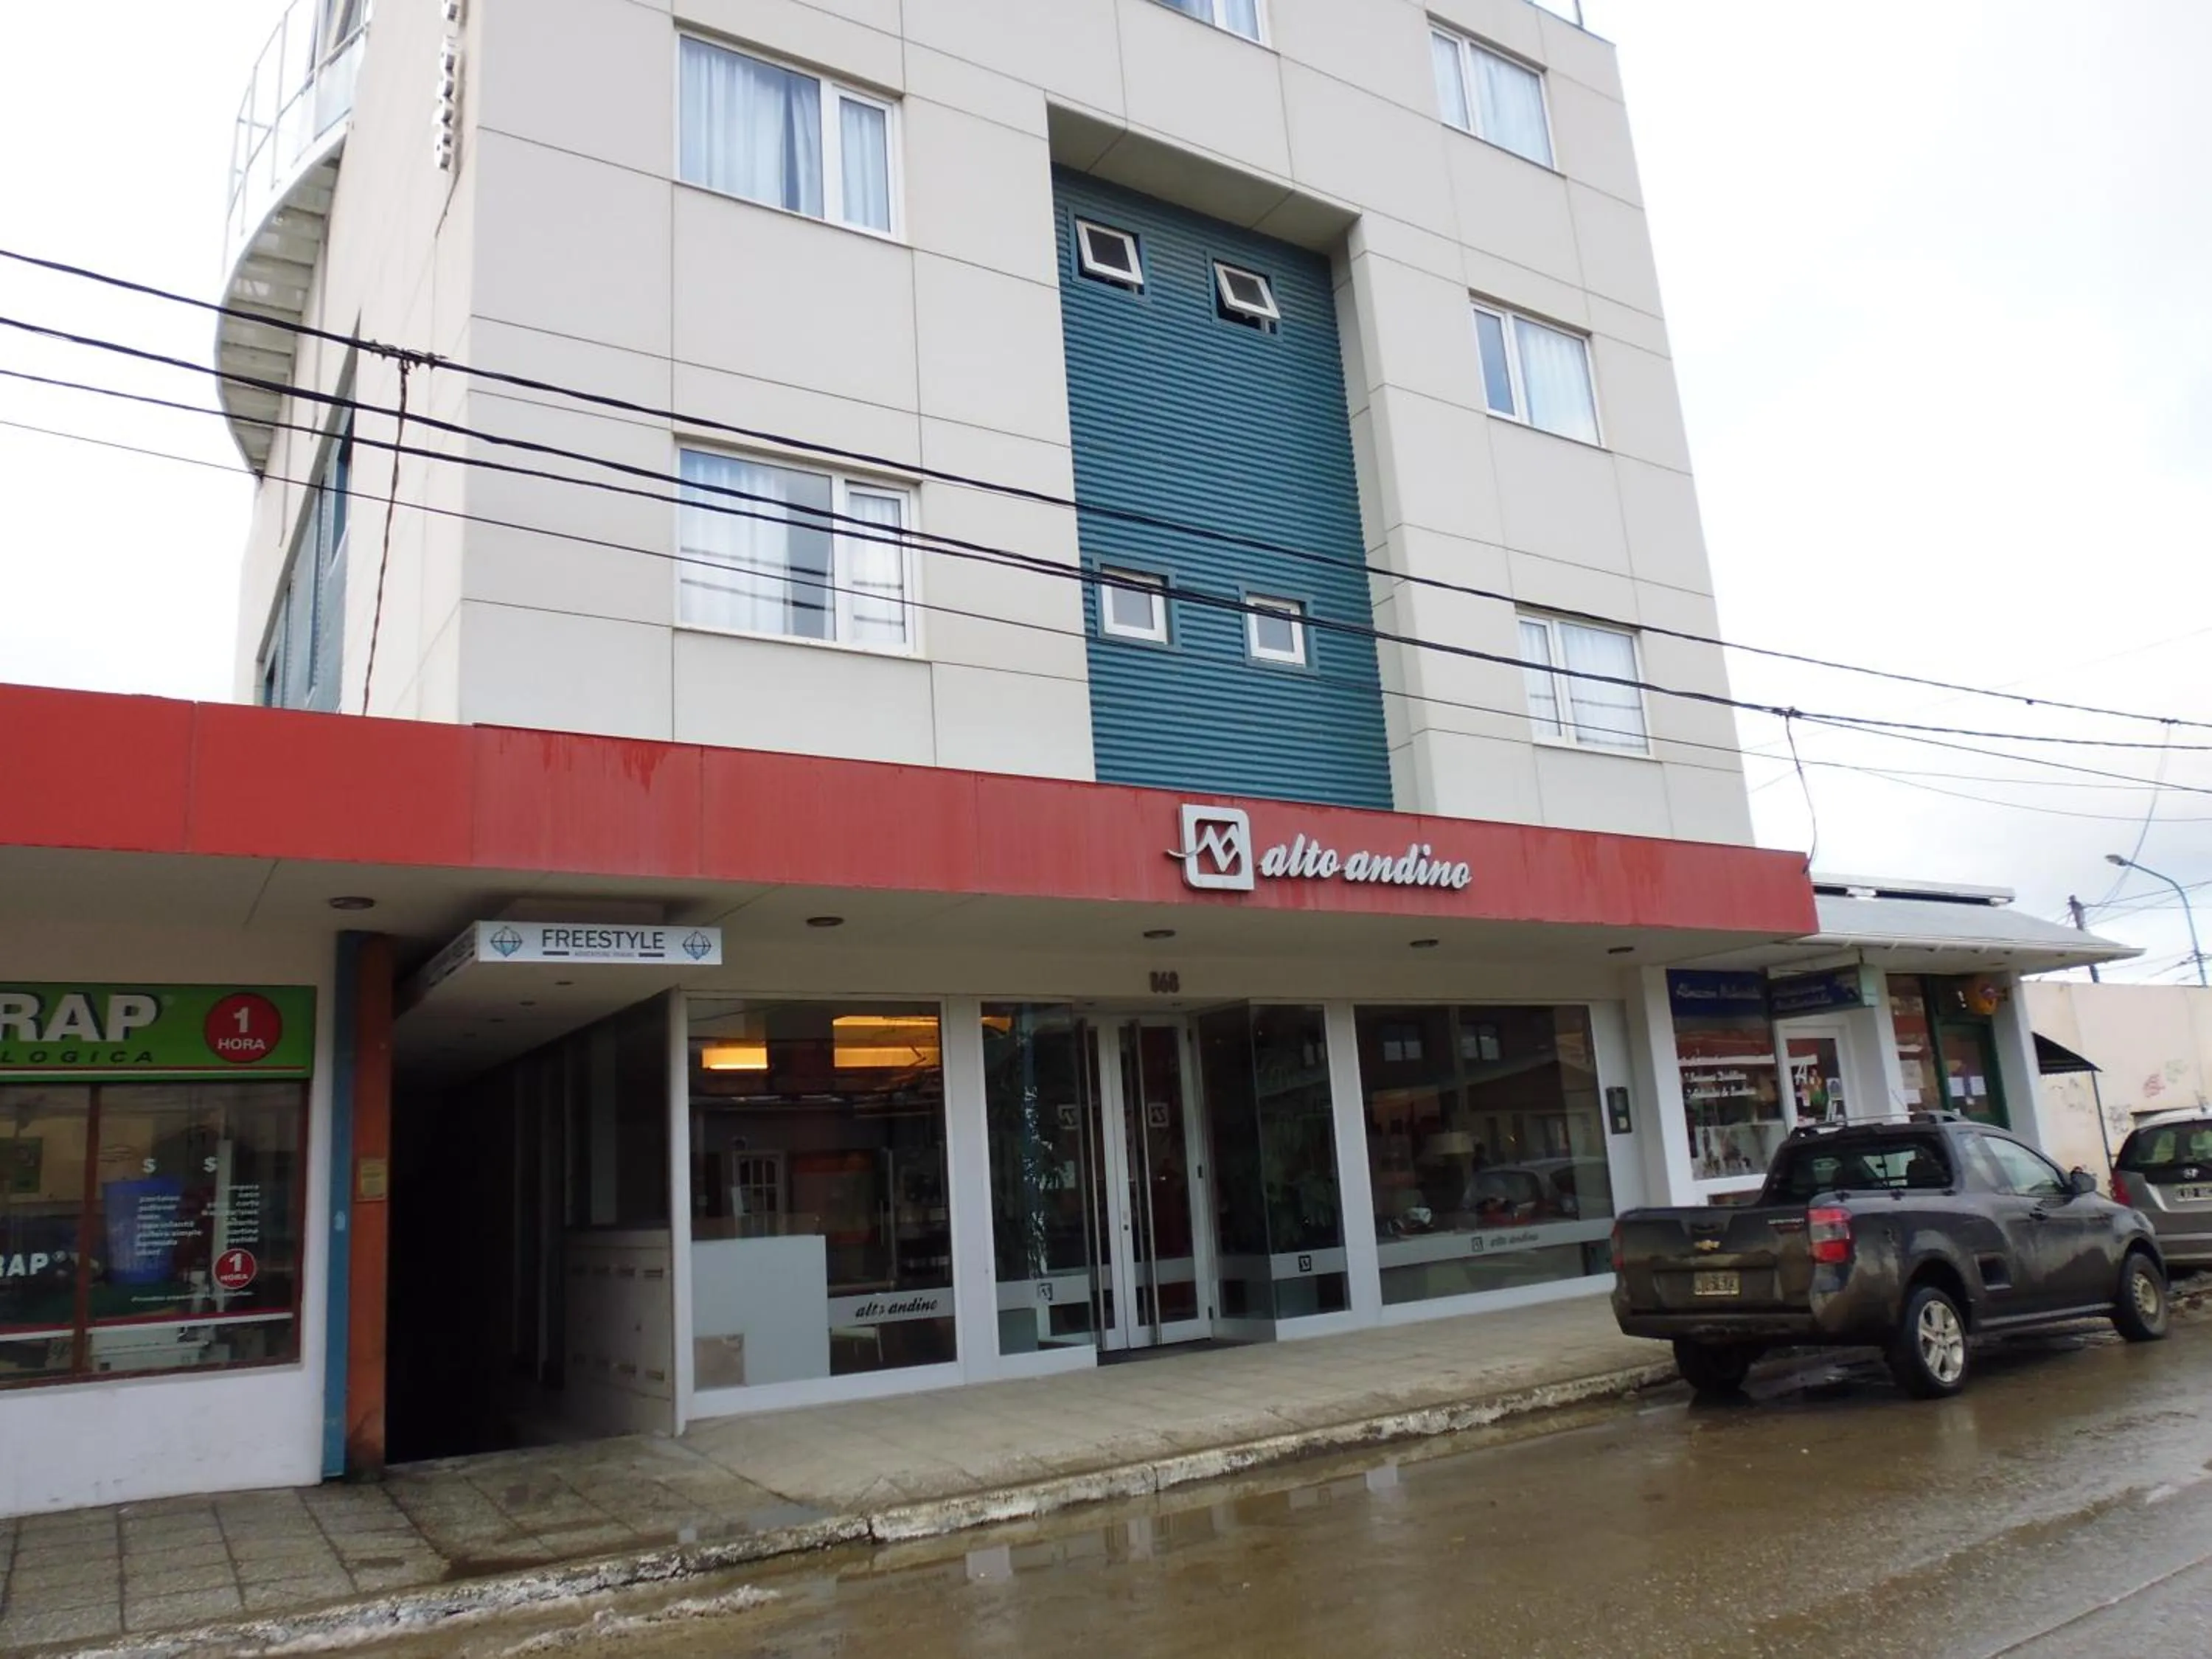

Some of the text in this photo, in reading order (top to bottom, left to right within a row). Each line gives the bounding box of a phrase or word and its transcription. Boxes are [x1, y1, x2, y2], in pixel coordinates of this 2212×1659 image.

[1258, 833, 1472, 889] alto andino
[542, 929, 665, 950] FREESTYLE
[233, 1007, 249, 1034] 1
[218, 1038, 266, 1051] HORA
[0, 1253, 49, 1277] AP
[229, 1253, 242, 1272] 1
